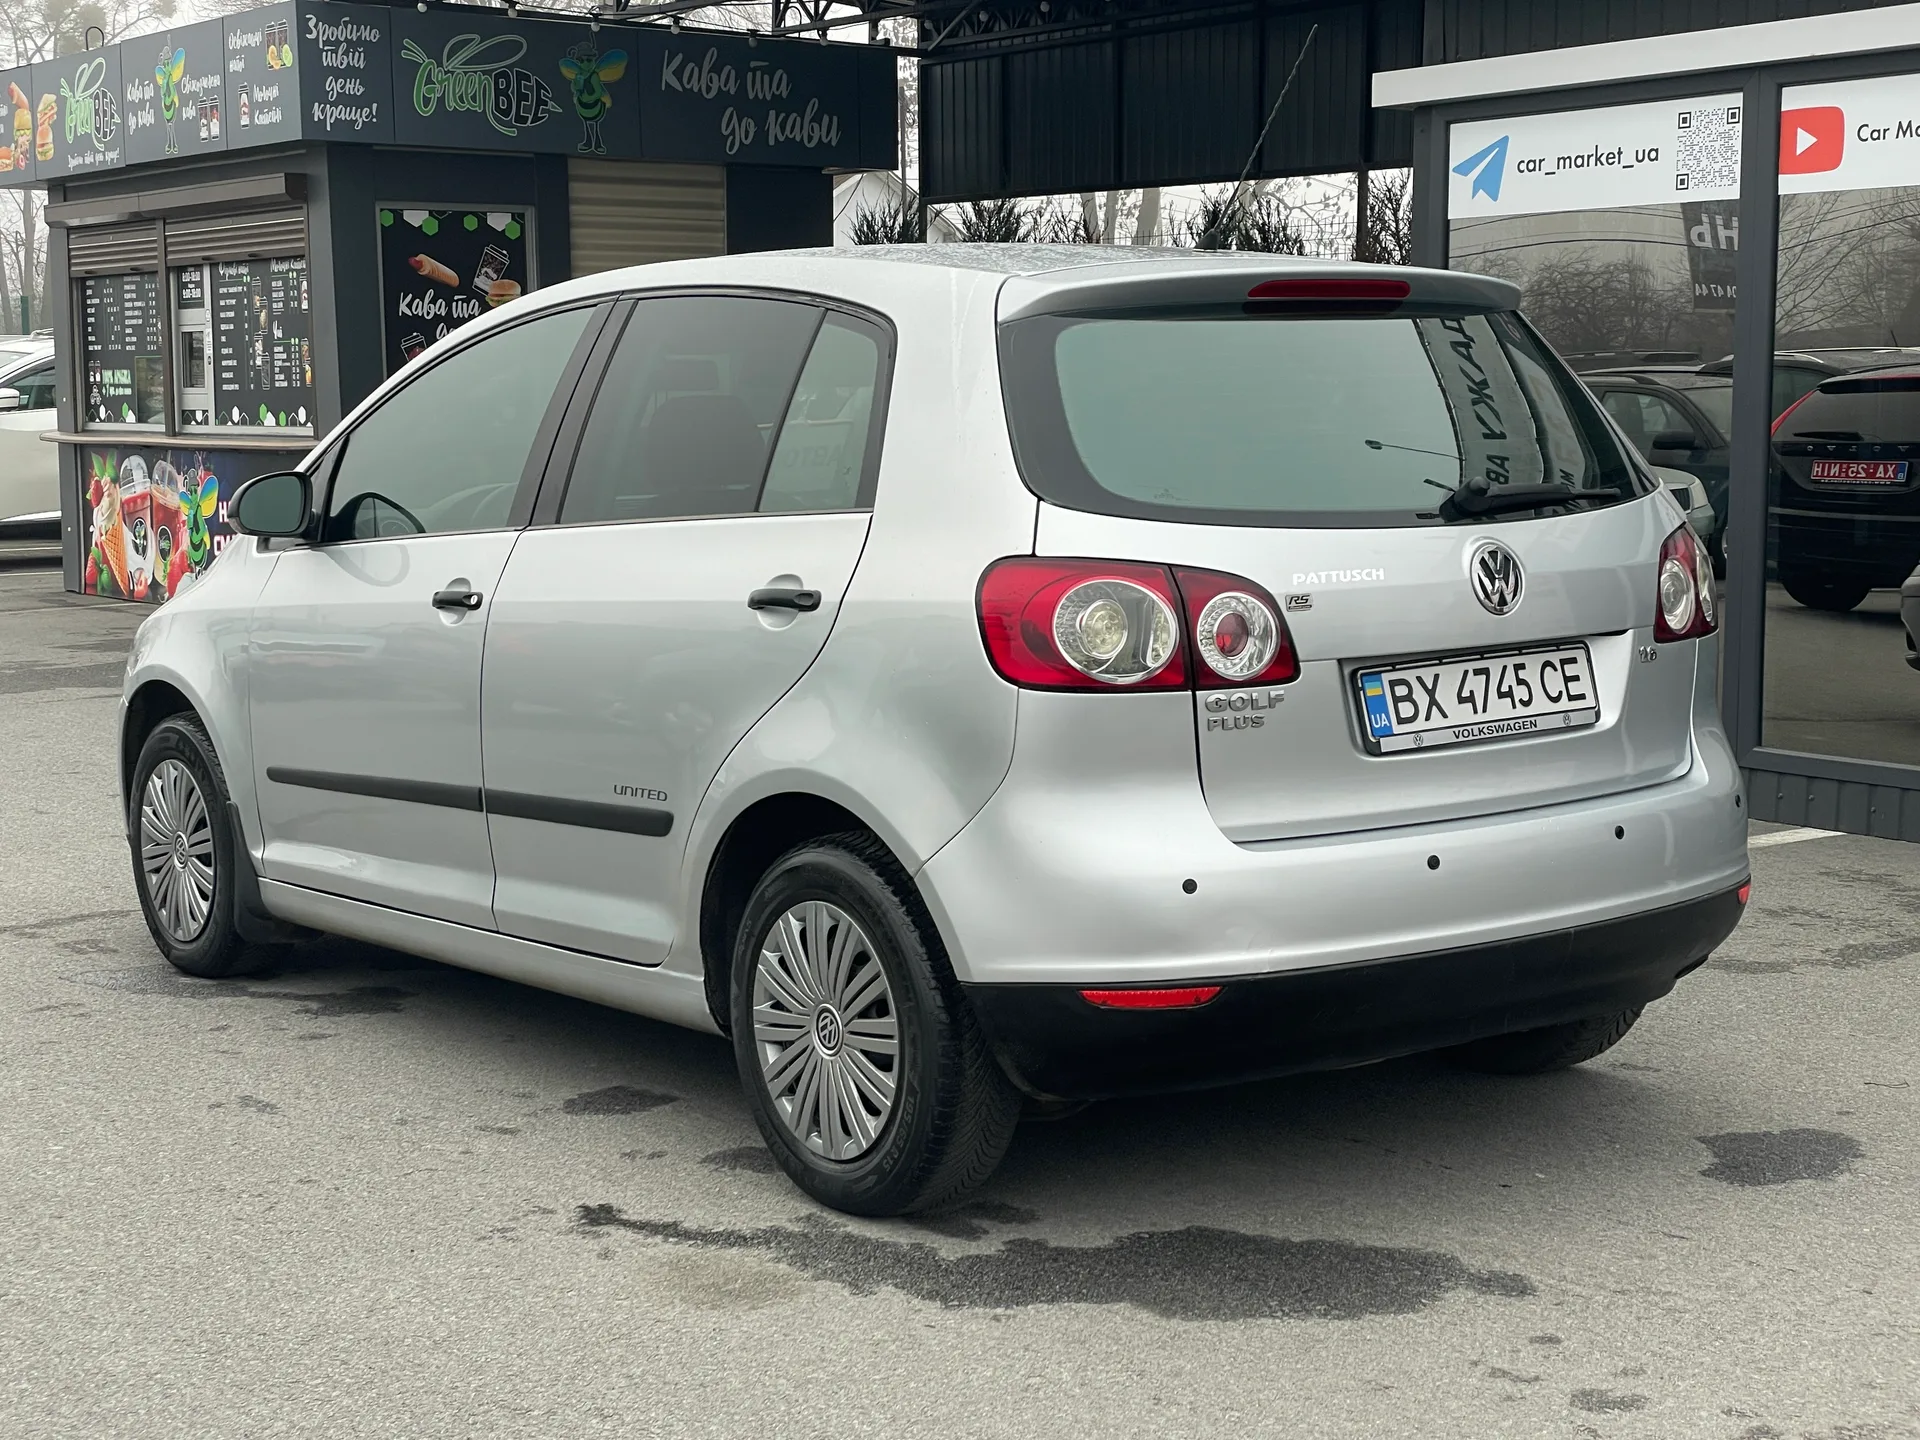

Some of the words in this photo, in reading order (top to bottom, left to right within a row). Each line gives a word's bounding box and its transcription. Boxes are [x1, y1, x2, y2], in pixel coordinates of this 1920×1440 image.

[305, 14, 380, 48] Зробимо
[322, 42, 366, 69] твій
[661, 47, 740, 99] Кава
[746, 61, 793, 100] та
[126, 78, 143, 103] Кава
[325, 75, 365, 100] день
[413, 59, 494, 117] Green
[492, 67, 553, 127] BEE
[137, 102, 155, 128] кави
[182, 100, 197, 121] кава
[311, 102, 378, 131] краще!
[721, 106, 757, 155] до
[764, 97, 842, 148] кави
[1857, 123, 1890, 142] Car
[1517, 144, 1660, 176] car_market_ua
[399, 288, 448, 319] Кава
[452, 295, 482, 318] та
[1292, 568, 1385, 586] PATTUSCH
[1288, 594, 1310, 605] RS
[1205, 690, 1285, 713] GOLF
[1388, 673, 1449, 726] BX
[1456, 662, 1534, 715] 4745
[1539, 657, 1587, 704] CE
[1207, 713, 1266, 732] PLUS
[1371, 712, 1390, 728] UA
[1452, 719, 1538, 740] VOLKSWAGEN
[613, 784, 668, 802] UNITED
